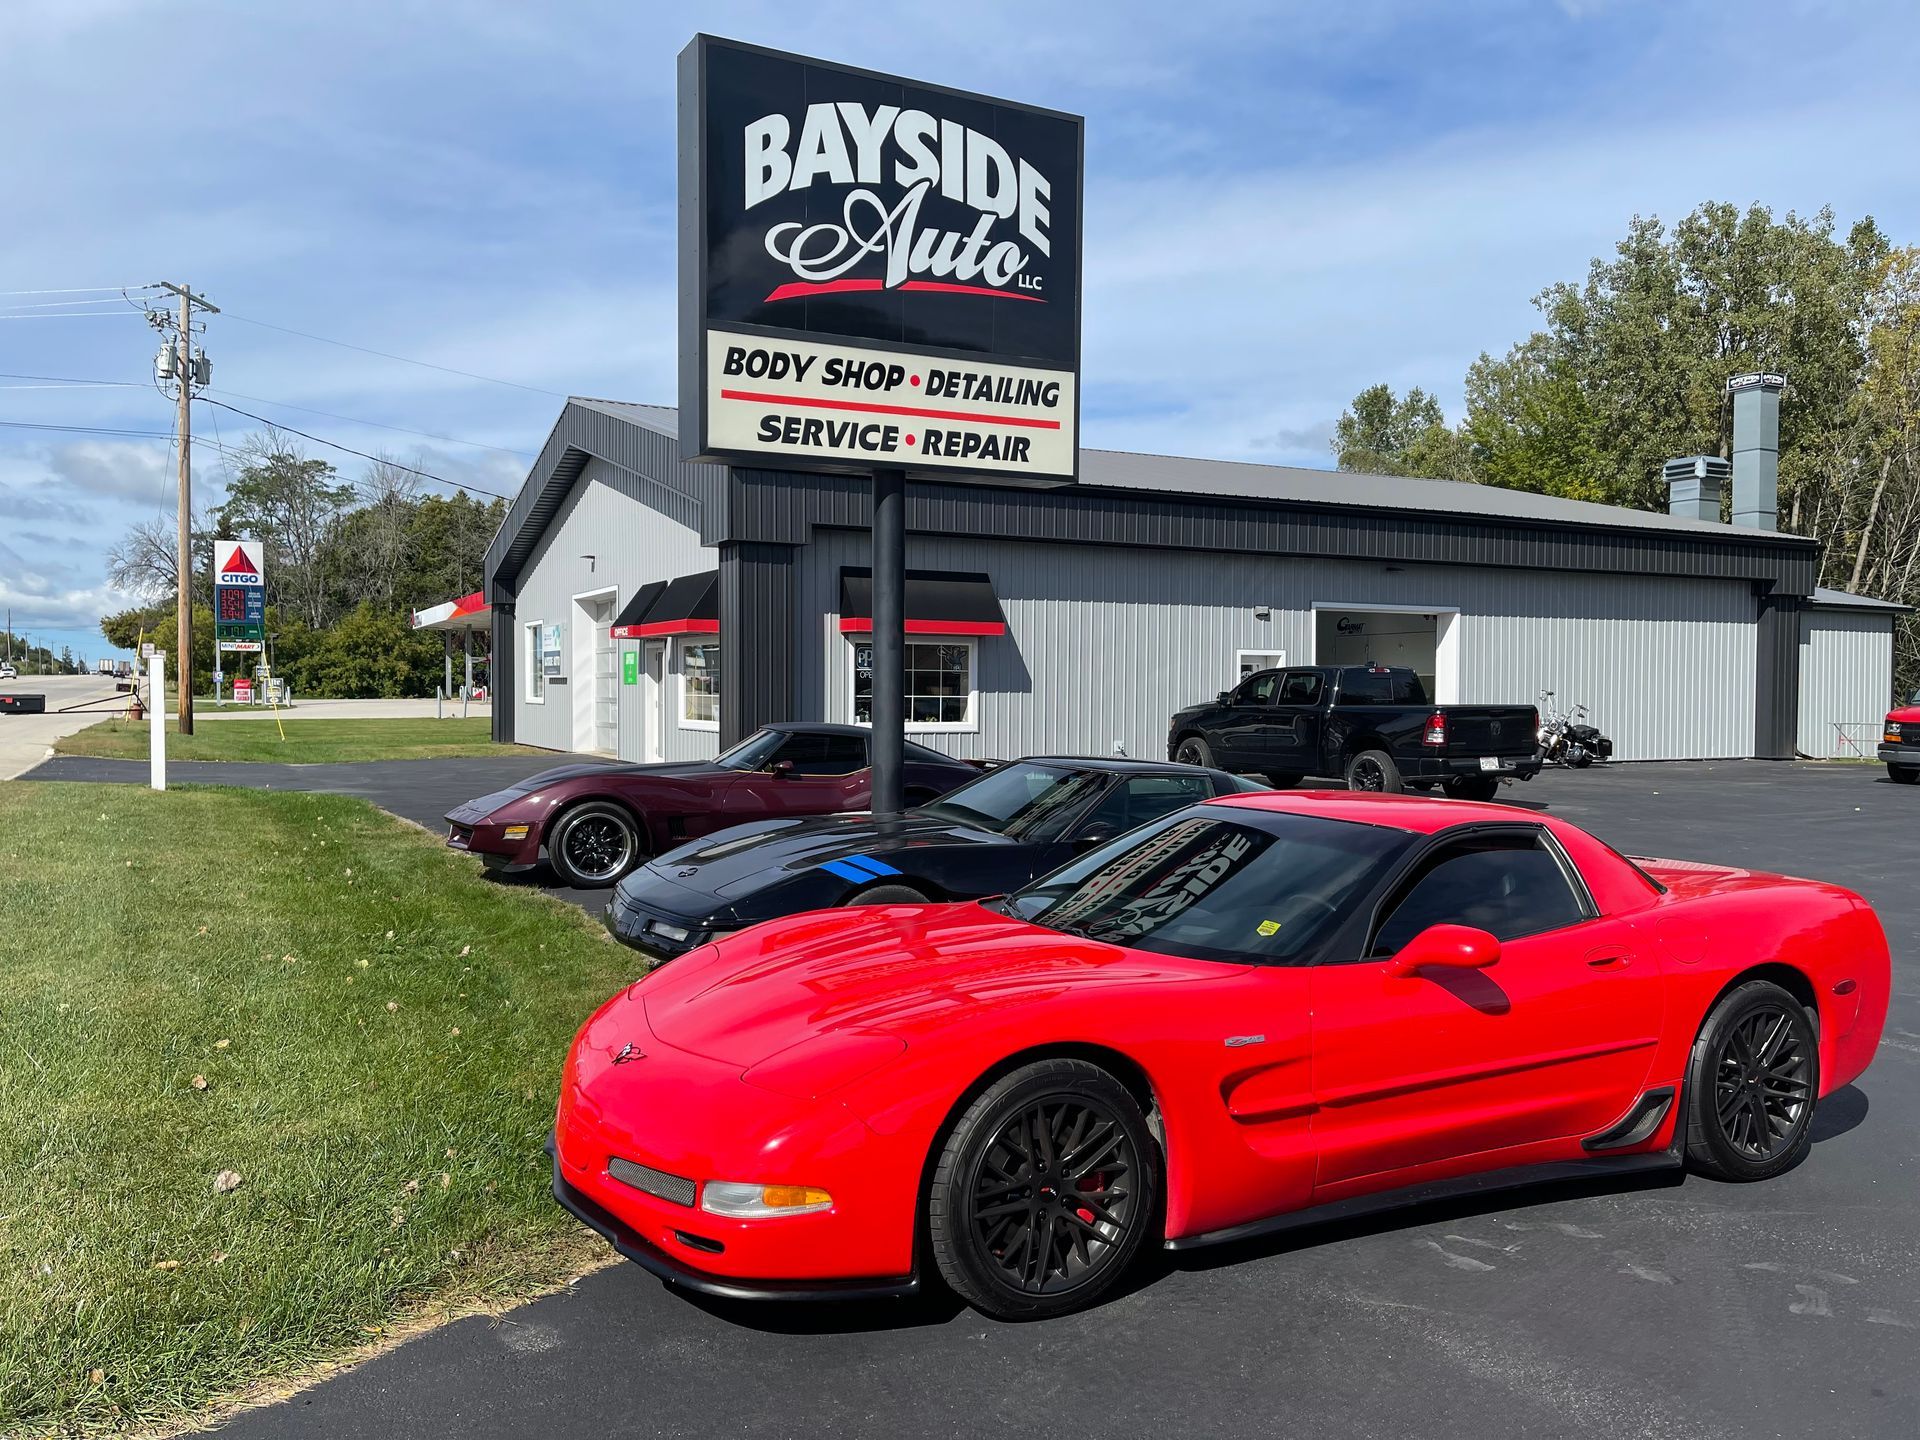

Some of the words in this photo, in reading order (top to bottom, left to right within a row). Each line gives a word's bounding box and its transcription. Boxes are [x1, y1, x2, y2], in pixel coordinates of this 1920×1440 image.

[744, 102, 1051, 258] BAYSIDE
[764, 182, 1029, 289] Auto
[1018, 275, 1043, 291] LLC
[723, 346, 817, 382] BODY
[822, 358, 905, 392] SHOP
[925, 370, 1060, 408] DETAILING
[757, 414, 899, 453] SERVICE
[922, 430, 1031, 463] REPAIR
[221, 574, 258, 583] CITGO
